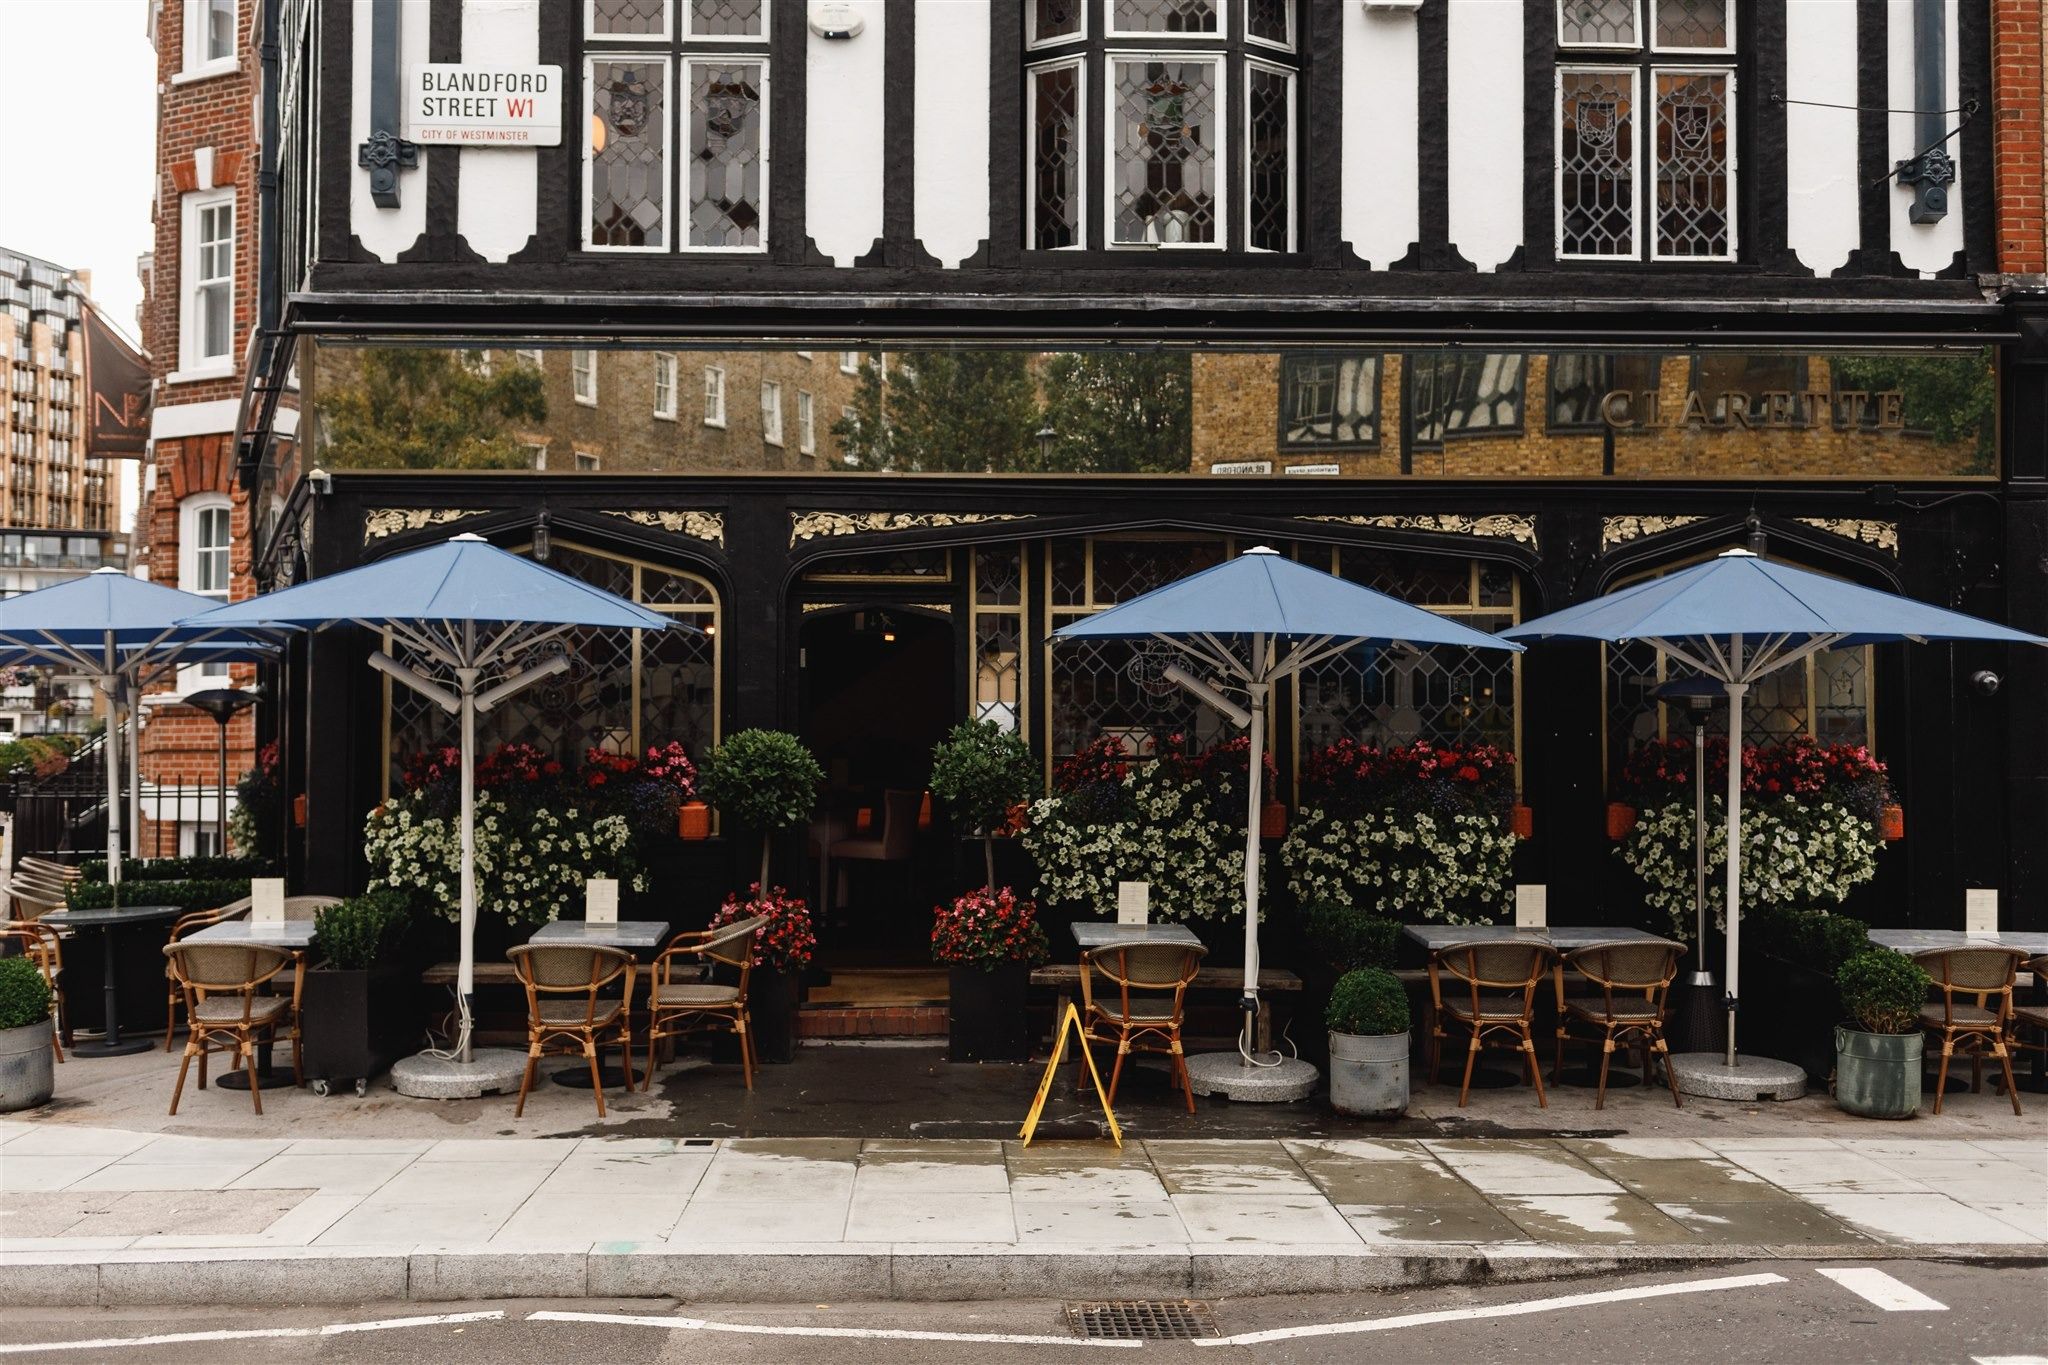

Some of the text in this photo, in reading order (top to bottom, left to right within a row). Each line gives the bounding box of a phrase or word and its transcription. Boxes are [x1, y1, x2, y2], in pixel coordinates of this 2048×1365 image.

[422, 72, 548, 93] BLANDFORD
[422, 97, 533, 118] STREET W1
[421, 129, 529, 141] CITY OF WESTMINSTER
[1602, 390, 1904, 429] CLARETTE
